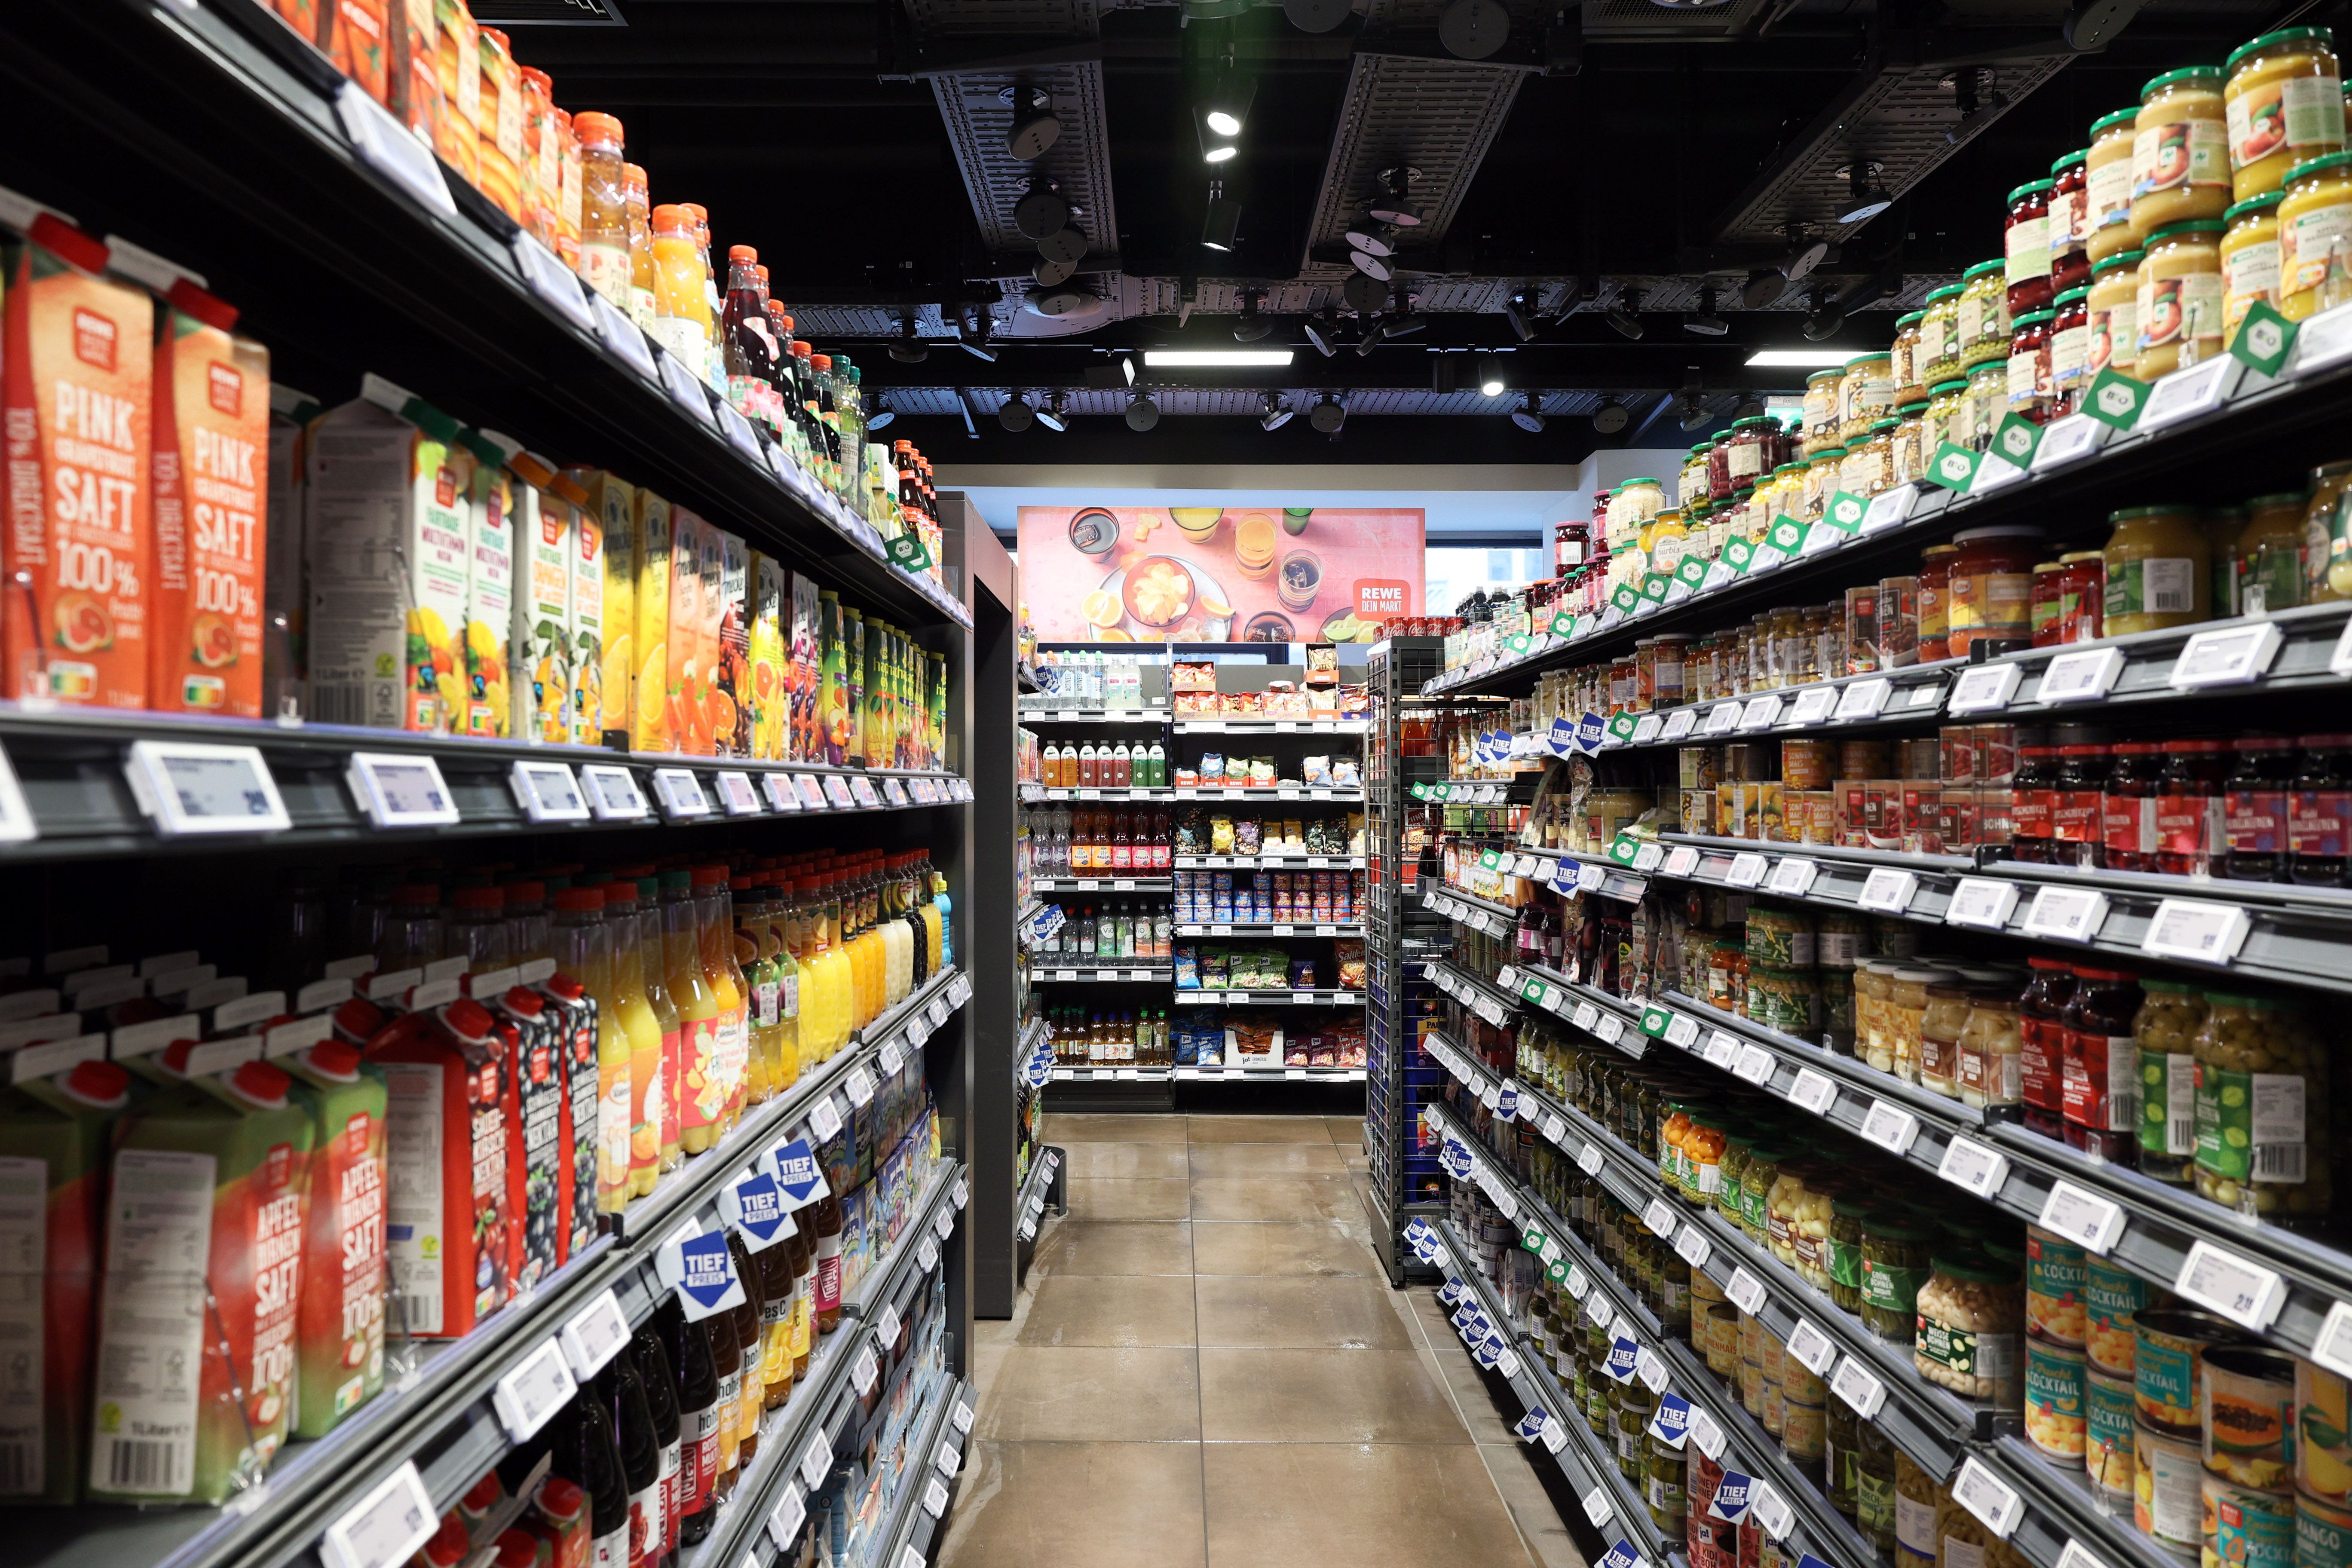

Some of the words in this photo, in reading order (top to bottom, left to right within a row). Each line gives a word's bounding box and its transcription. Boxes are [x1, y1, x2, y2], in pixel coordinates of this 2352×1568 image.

[55, 380, 135, 451] PINK
[2009, 432, 2026, 445] BIO
[193, 426, 255, 487] PINK
[1947, 460, 1965, 472] BIO
[56, 467, 136, 533] SAFT
[1841, 505, 1856, 515] BIO
[193, 503, 255, 561] SAFT
[1780, 529, 1795, 539] BIO
[898, 544, 910, 552] BIO
[1733, 548, 1745, 557] BIO
[57, 542, 139, 597] 100%
[1687, 566, 1699, 575] BIO
[195, 567, 257, 616] 100%
[1362, 588, 1402, 599] REWE
[1622, 594, 1631, 602] BIO
[1362, 601, 1378, 612] DEIN
[1380, 600, 1402, 612] MARKT
[1173, 683, 1192, 691] Lorenz
[1553, 729, 1572, 739] TIEF
[1583, 724, 1602, 735] TIEF
[1495, 739, 1510, 748] TIEF
[1559, 867, 1577, 877] TIEF
[780, 1157, 811, 1174] TIEF
[1457, 1158, 1470, 1167] TIEF
[341, 1158, 381, 1204] APFEL
[786, 1174, 809, 1182] PREIS
[742, 1192, 776, 1211] TIEF
[257, 1194, 300, 1241] APFEL
[749, 1211, 775, 1221] PREIS
[1412, 1223, 1424, 1233] TIEF
[342, 1214, 381, 1271] SAFT
[1423, 1240, 1435, 1250] TIEF
[686, 1253, 725, 1273] TIEF
[1871, 1271, 1892, 1283] GRÜNE
[2044, 1264, 2086, 1281] COCKTA
[692, 1273, 721, 1284] PREIS
[1870, 1277, 1894, 1290] BOHNEN
[255, 1256, 300, 1317] SAFT
[1448, 1282, 1460, 1291] TIEF
[1462, 1307, 1475, 1317] TIEF
[1470, 1330, 1481, 1338] PREIS
[1472, 1323, 1485, 1334] TIEF
[1927, 1326, 1950, 1341] WEISSE
[1926, 1332, 1951, 1351] BOHNEN
[1483, 1350, 1495, 1358] PREIS
[1485, 1343, 1500, 1354] TIEF
[1614, 1348, 1635, 1360] TIEF
[1528, 1413, 1541, 1424] TIEF
[1663, 1406, 1687, 1421] TIEF
[1664, 1419, 1682, 1429] PREIS
[1722, 1485, 1746, 1497] TIEF
[1699, 1527, 1709, 1539] ja!
[1612, 1550, 1632, 1567] TIEF
